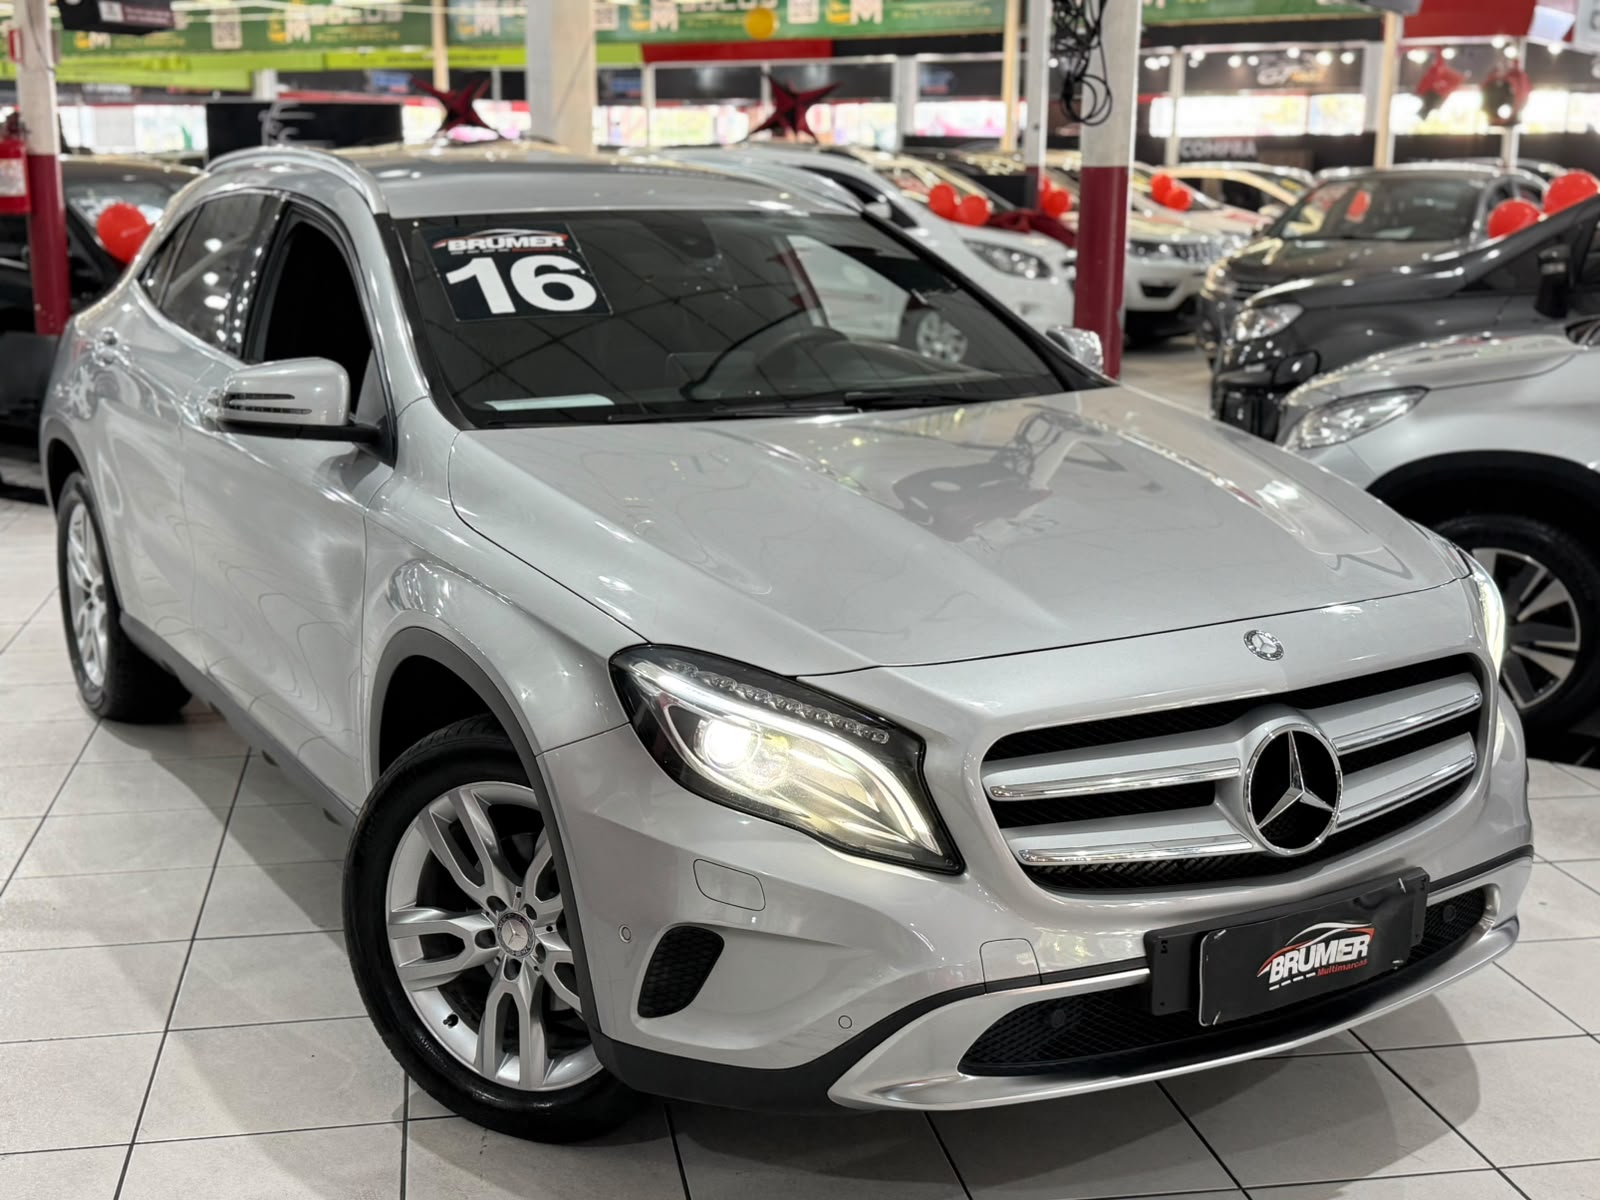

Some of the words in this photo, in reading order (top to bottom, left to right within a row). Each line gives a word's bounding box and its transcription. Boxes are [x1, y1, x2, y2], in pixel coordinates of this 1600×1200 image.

[447, 235, 565, 252] BRUMER
[445, 255, 597, 314] 16
[1268, 934, 1371, 984] BRUMER
[1317, 958, 1369, 976] Multimarcas
